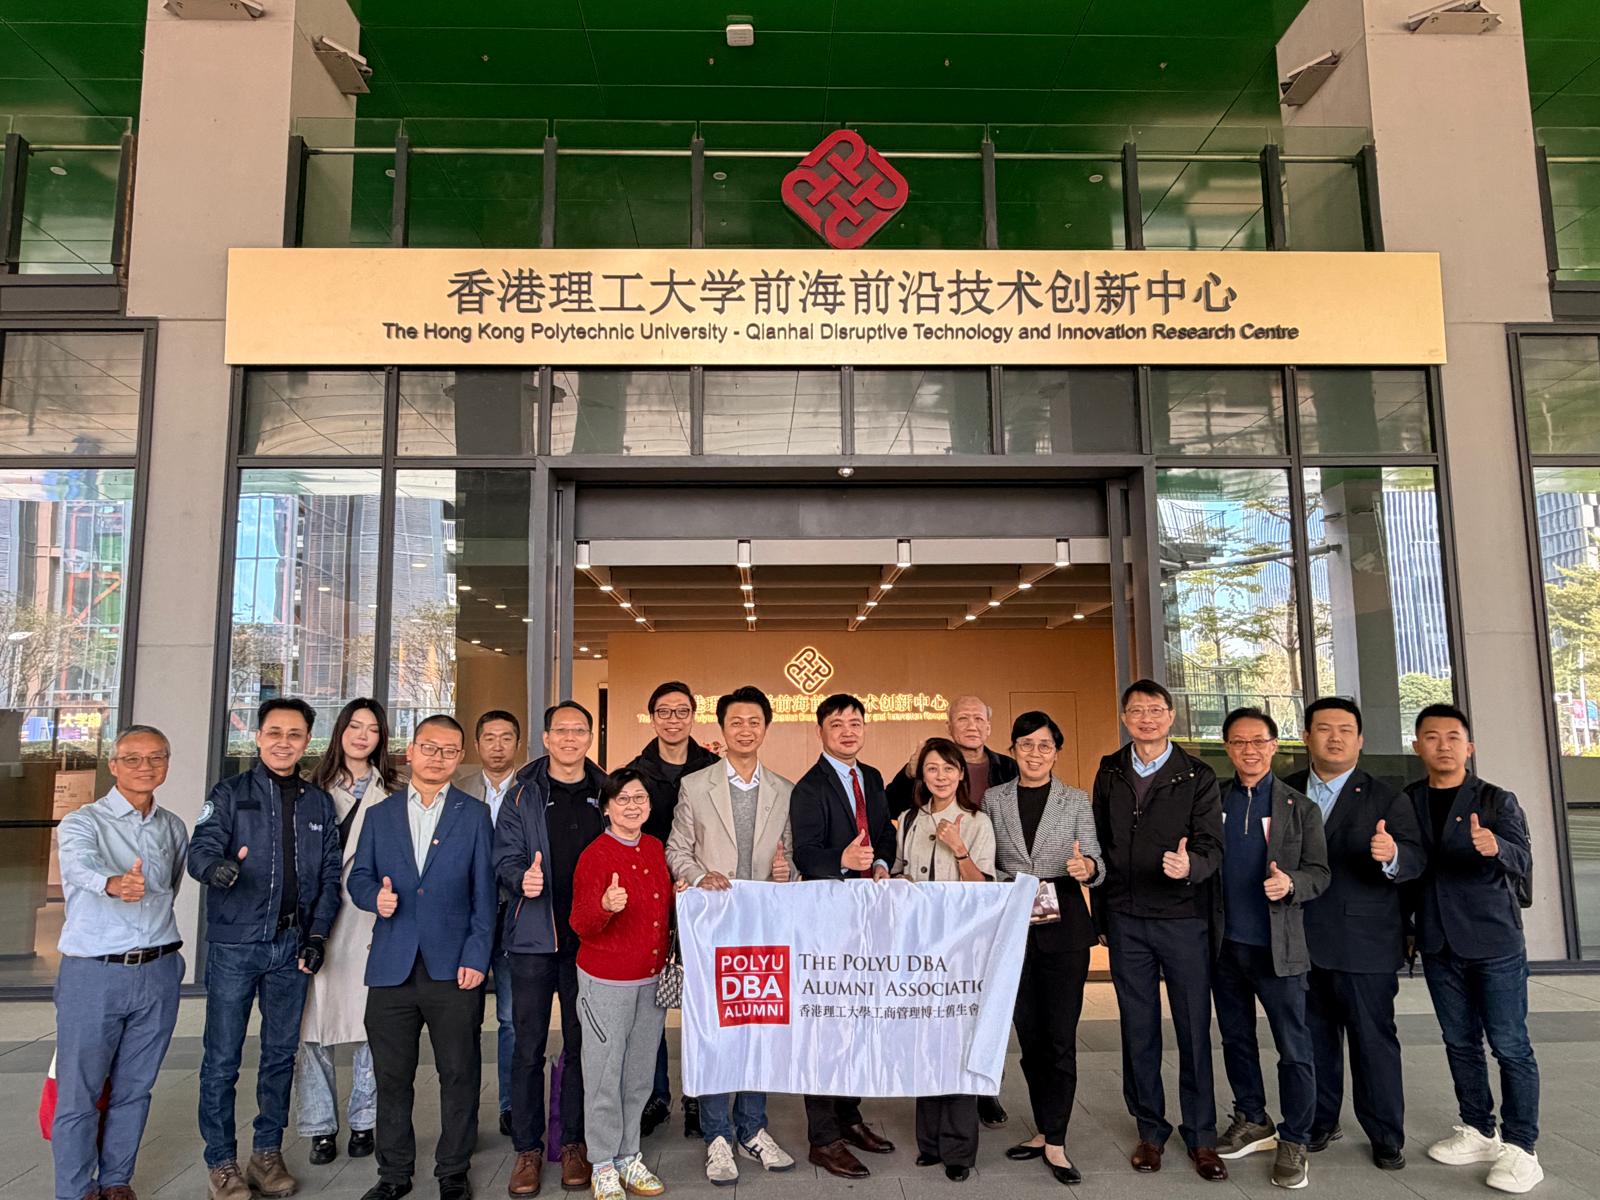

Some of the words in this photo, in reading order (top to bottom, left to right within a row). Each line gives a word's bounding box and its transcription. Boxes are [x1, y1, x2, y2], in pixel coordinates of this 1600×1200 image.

[446, 267, 1238, 316] 香港理工大学前海前沿技术创新中心
[382, 322, 419, 340] The
[424, 322, 472, 344] Hong
[478, 322, 525, 344] Kong
[531, 322, 635, 344] Polytechnic
[640, 322, 728, 344] University
[746, 322, 814, 341] Qianhai
[820, 323, 908, 343] Disruptive
[912, 323, 1014, 344] Technology
[1018, 323, 1051, 340] and
[1057, 323, 1147, 341] Innovation
[1152, 323, 1236, 340] Research
[1239, 322, 1300, 340] Centre
[721, 954, 784, 972] POLYU
[798, 953, 836, 971] THE
[908, 955, 948, 972] DBA
[722, 975, 783, 999] DBA
[802, 978, 875, 996] ALUMNI
[724, 1002, 784, 1019] ALUMNI
